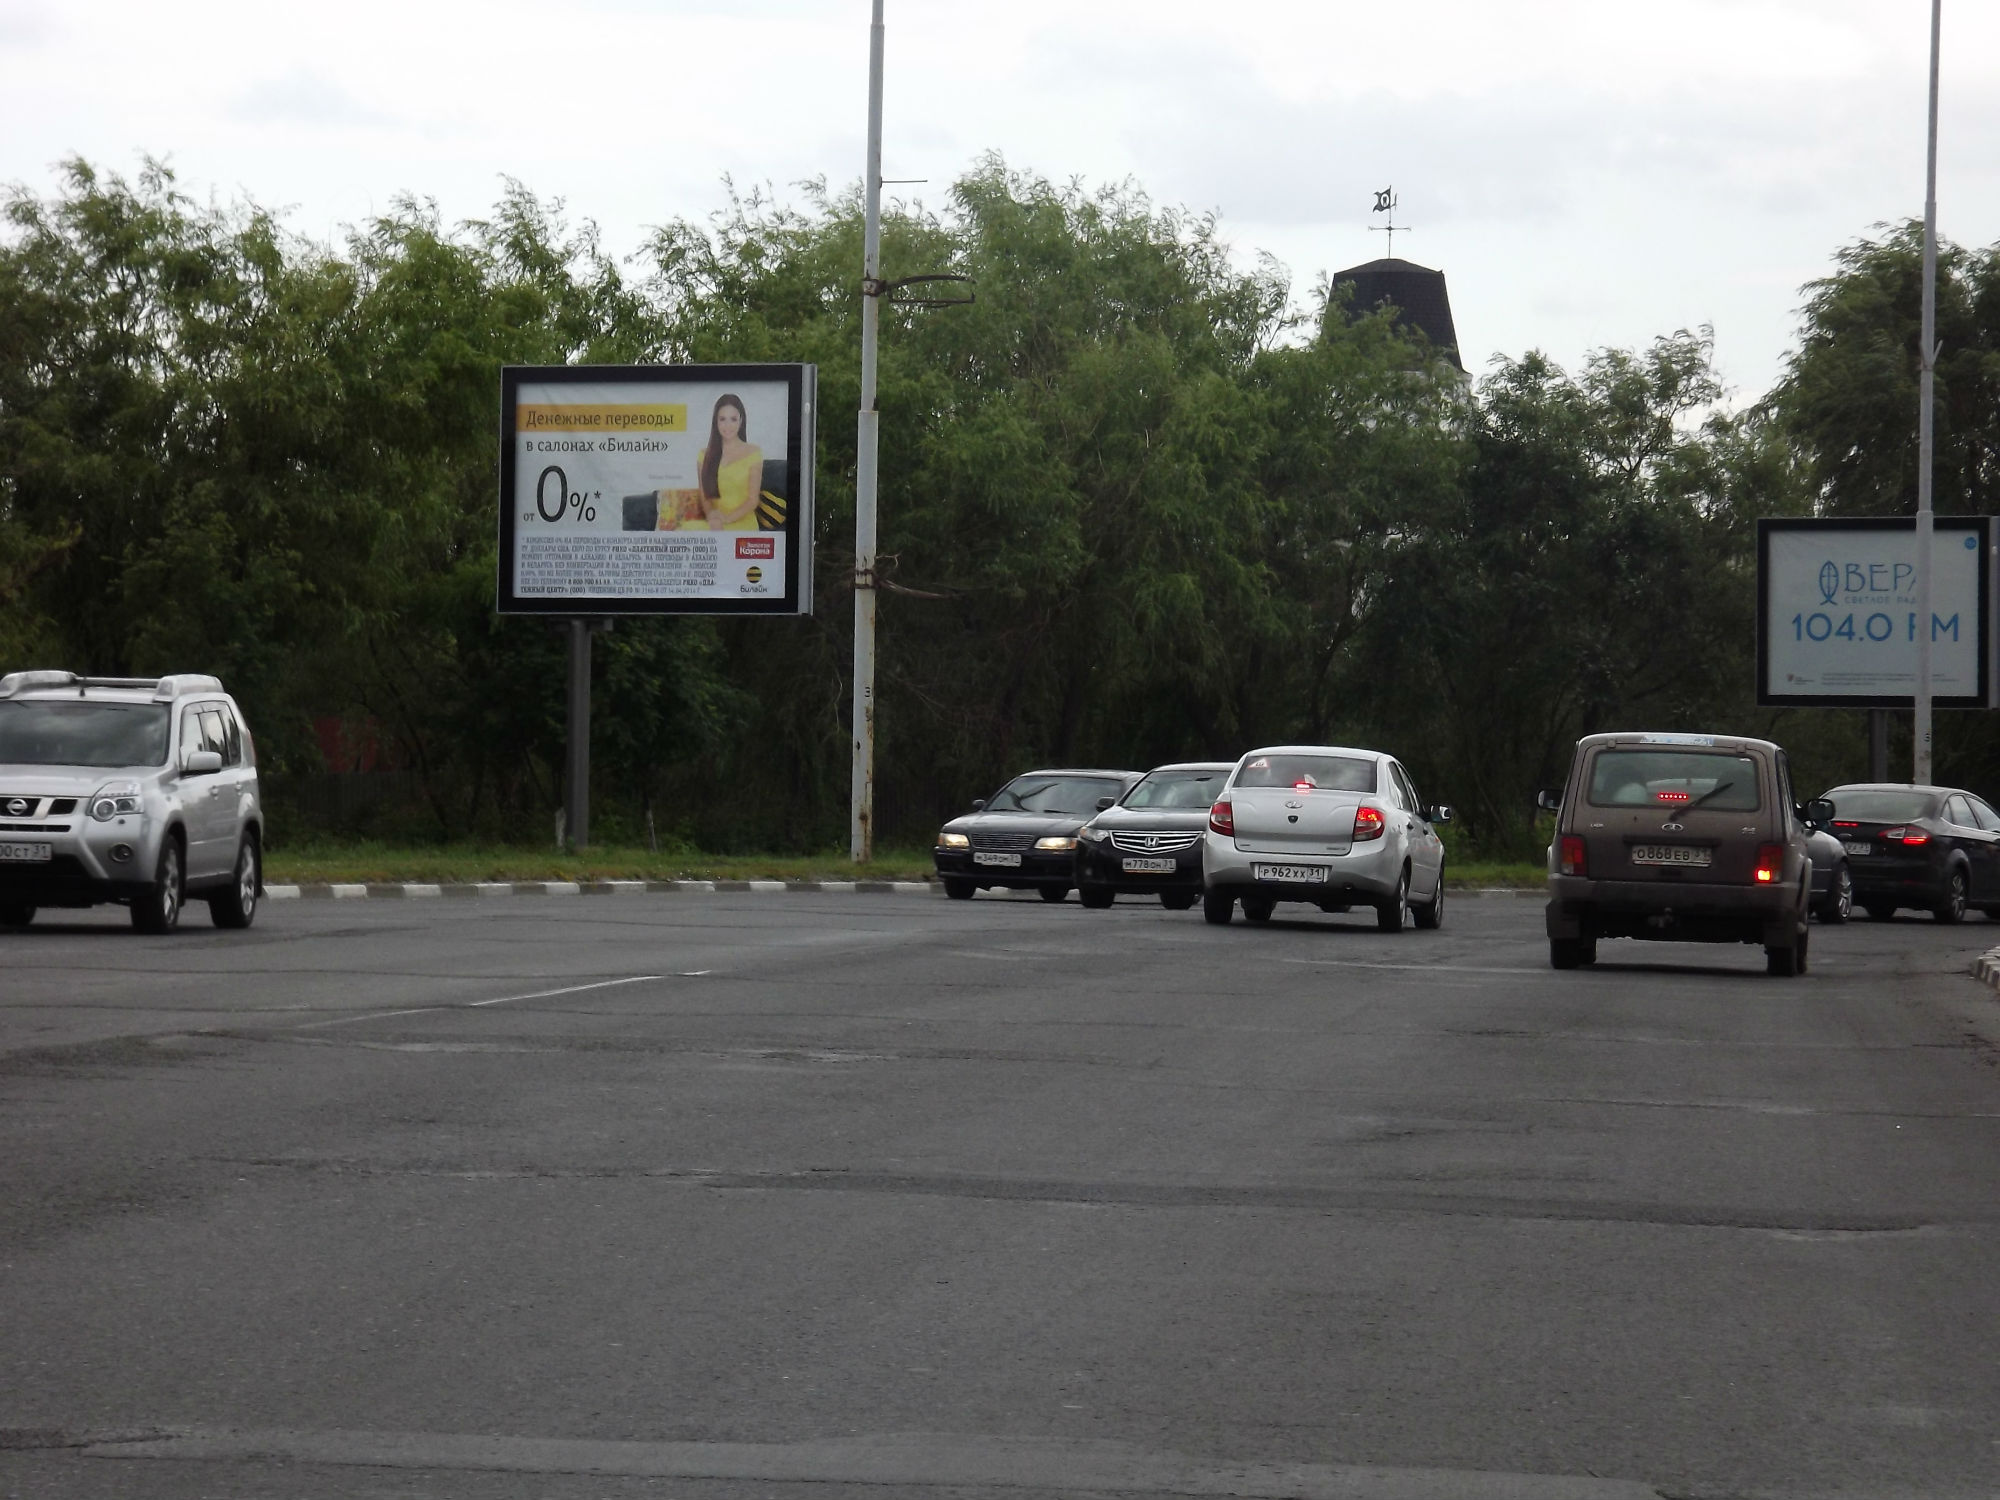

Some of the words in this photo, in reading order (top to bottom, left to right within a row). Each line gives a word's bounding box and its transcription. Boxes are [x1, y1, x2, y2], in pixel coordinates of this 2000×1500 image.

[526, 410, 600, 427] Денежные
[605, 414, 674, 429] переводы
[526, 440, 533, 452] в
[537, 440, 594, 452] салонах
[598, 437, 669, 452] «Билайн»
[523, 513, 535, 522] от
[740, 546, 770, 556] Корона
[1792, 612, 1893, 642] 104.0
